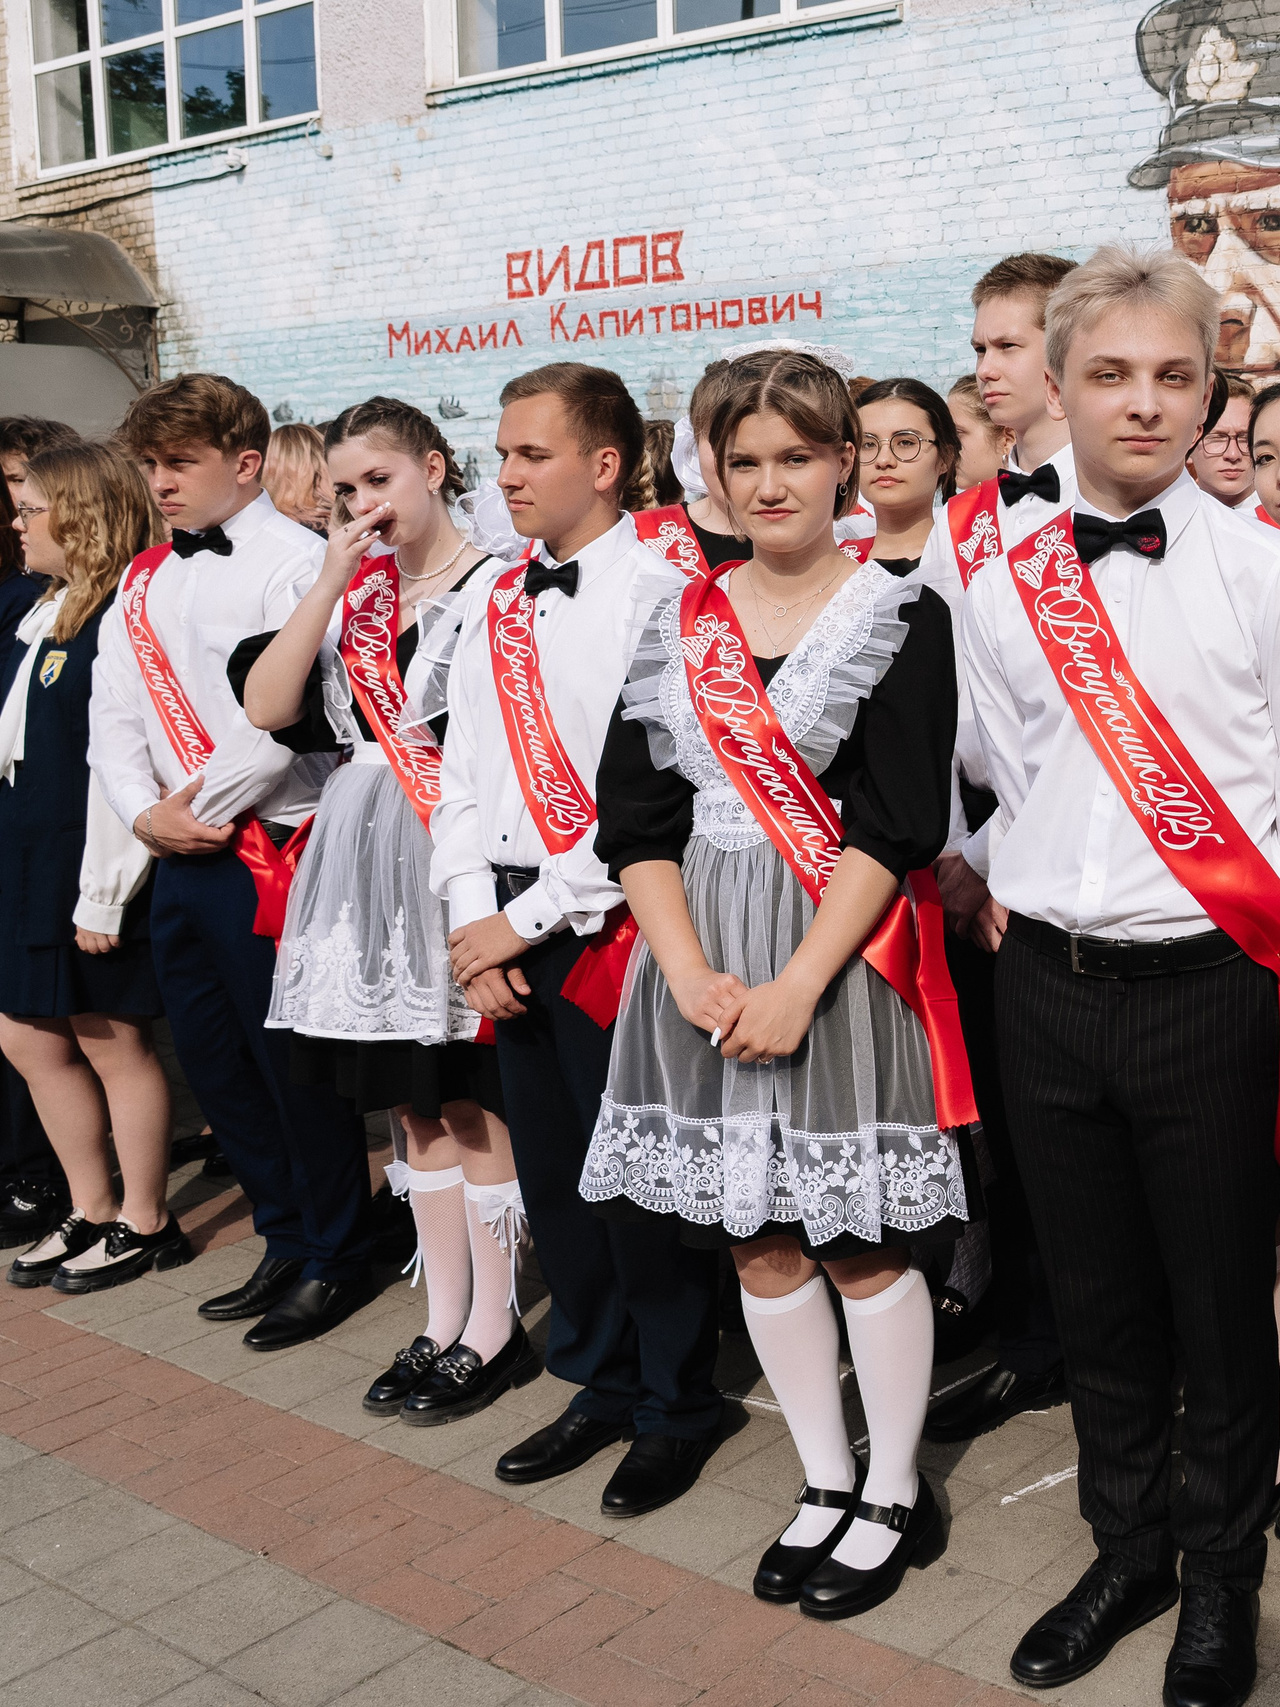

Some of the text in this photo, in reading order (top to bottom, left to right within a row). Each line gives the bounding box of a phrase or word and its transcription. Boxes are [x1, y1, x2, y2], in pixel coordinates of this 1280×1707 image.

[507, 230, 685, 300] ВИДОВ
[387, 291, 823, 358] Михаил Капитонович
